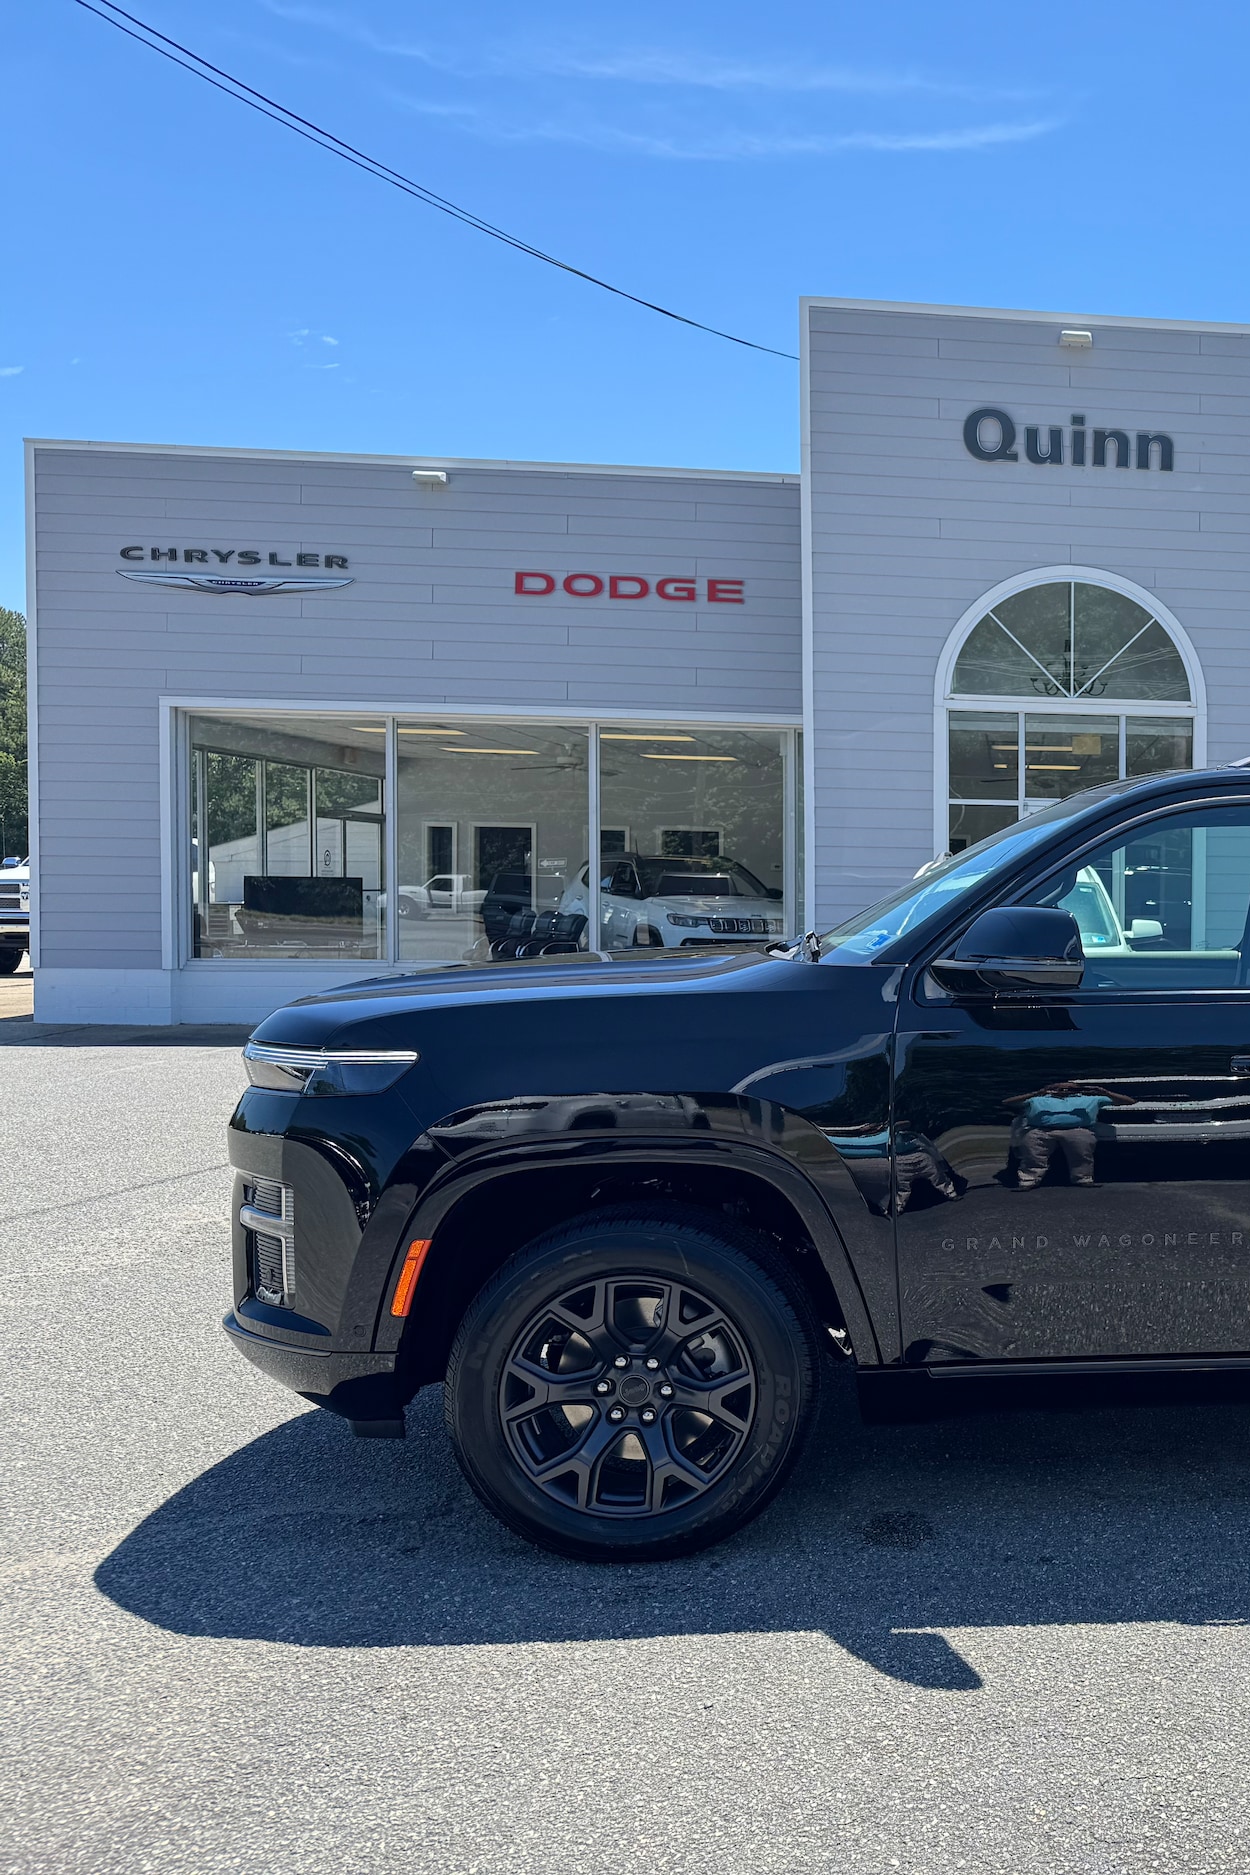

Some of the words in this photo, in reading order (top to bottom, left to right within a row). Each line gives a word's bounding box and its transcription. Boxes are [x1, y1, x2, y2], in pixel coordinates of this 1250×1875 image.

[963, 406, 1174, 472] Quinn
[119, 545, 349, 569] CHRYSLER
[515, 571, 745, 604] DODGE
[941, 1236, 1049, 1250] GRAND
[1072, 1231, 1244, 1249] WAGONEER
